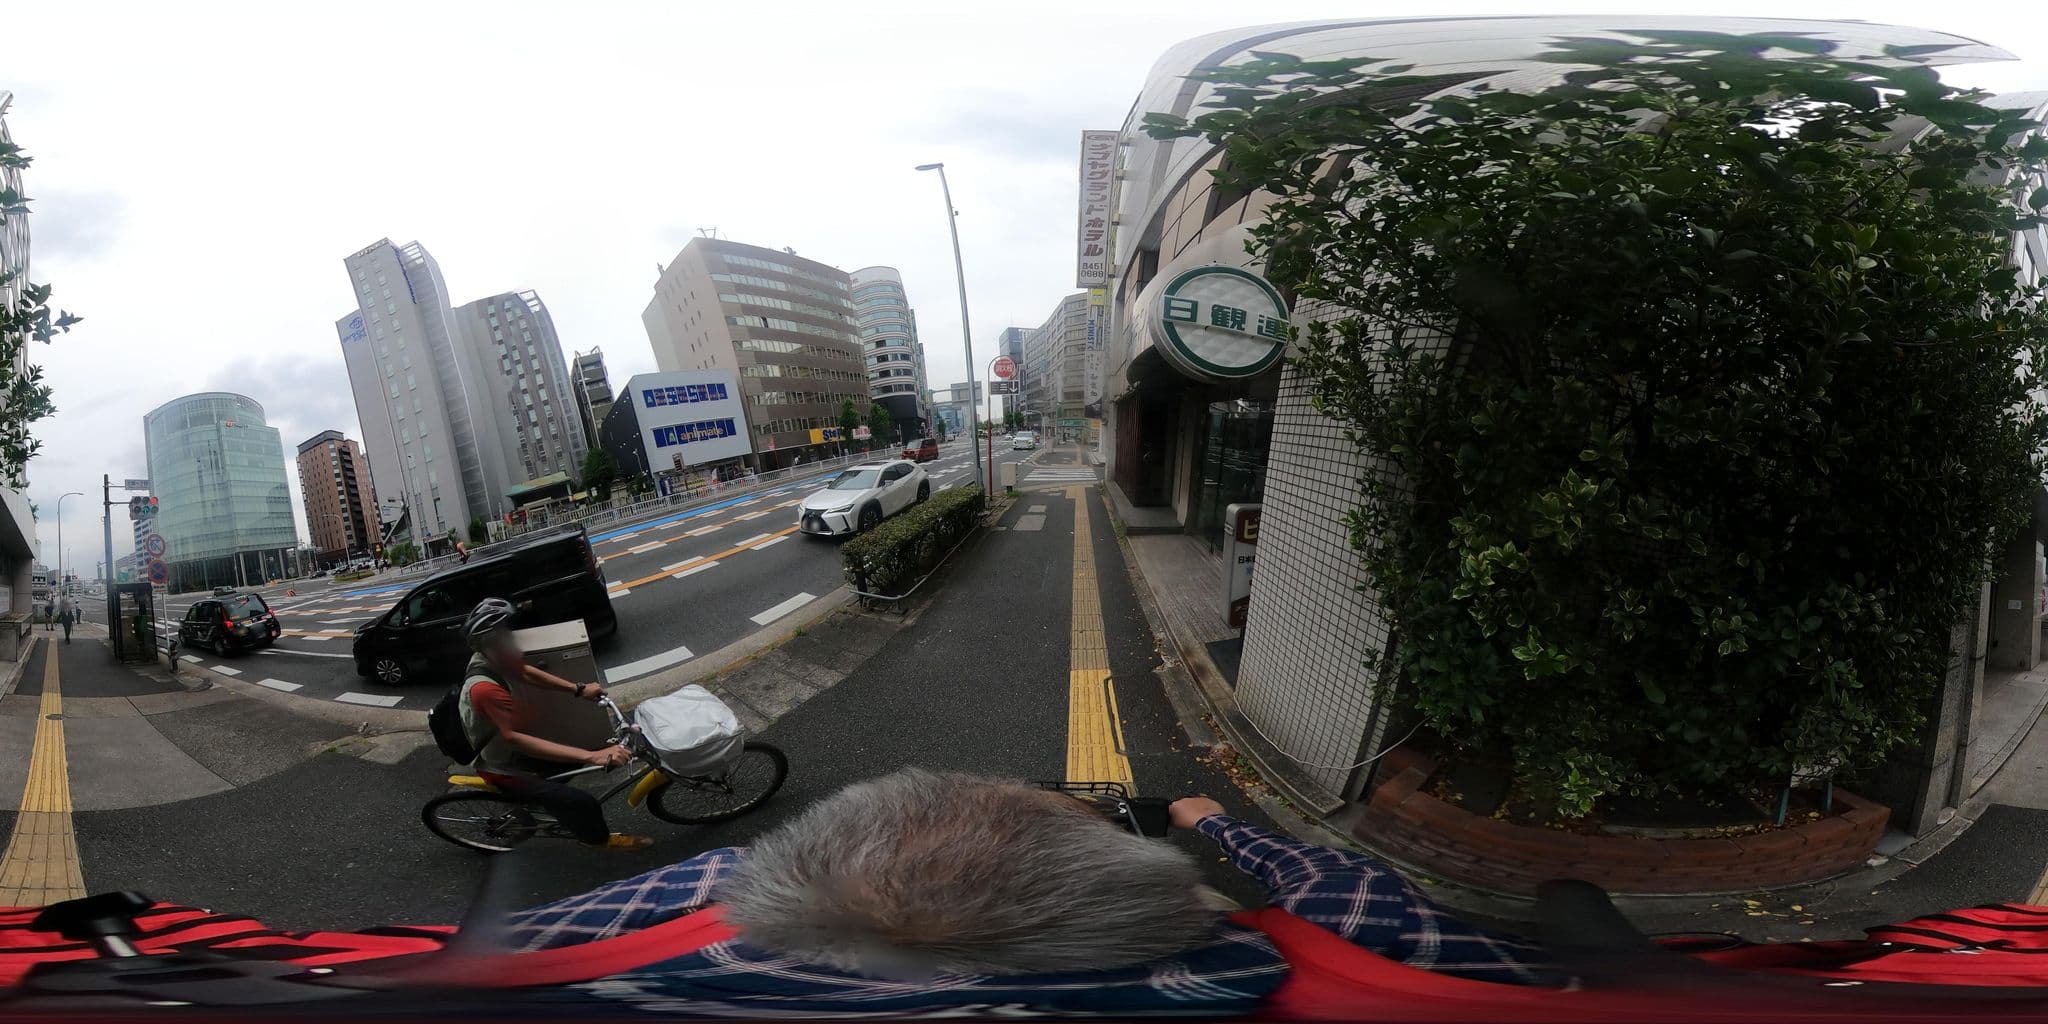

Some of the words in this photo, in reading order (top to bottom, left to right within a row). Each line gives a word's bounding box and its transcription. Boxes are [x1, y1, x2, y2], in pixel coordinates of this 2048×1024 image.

[1163, 296, 1288, 342] 日観連
[680, 426, 725, 441] animate
